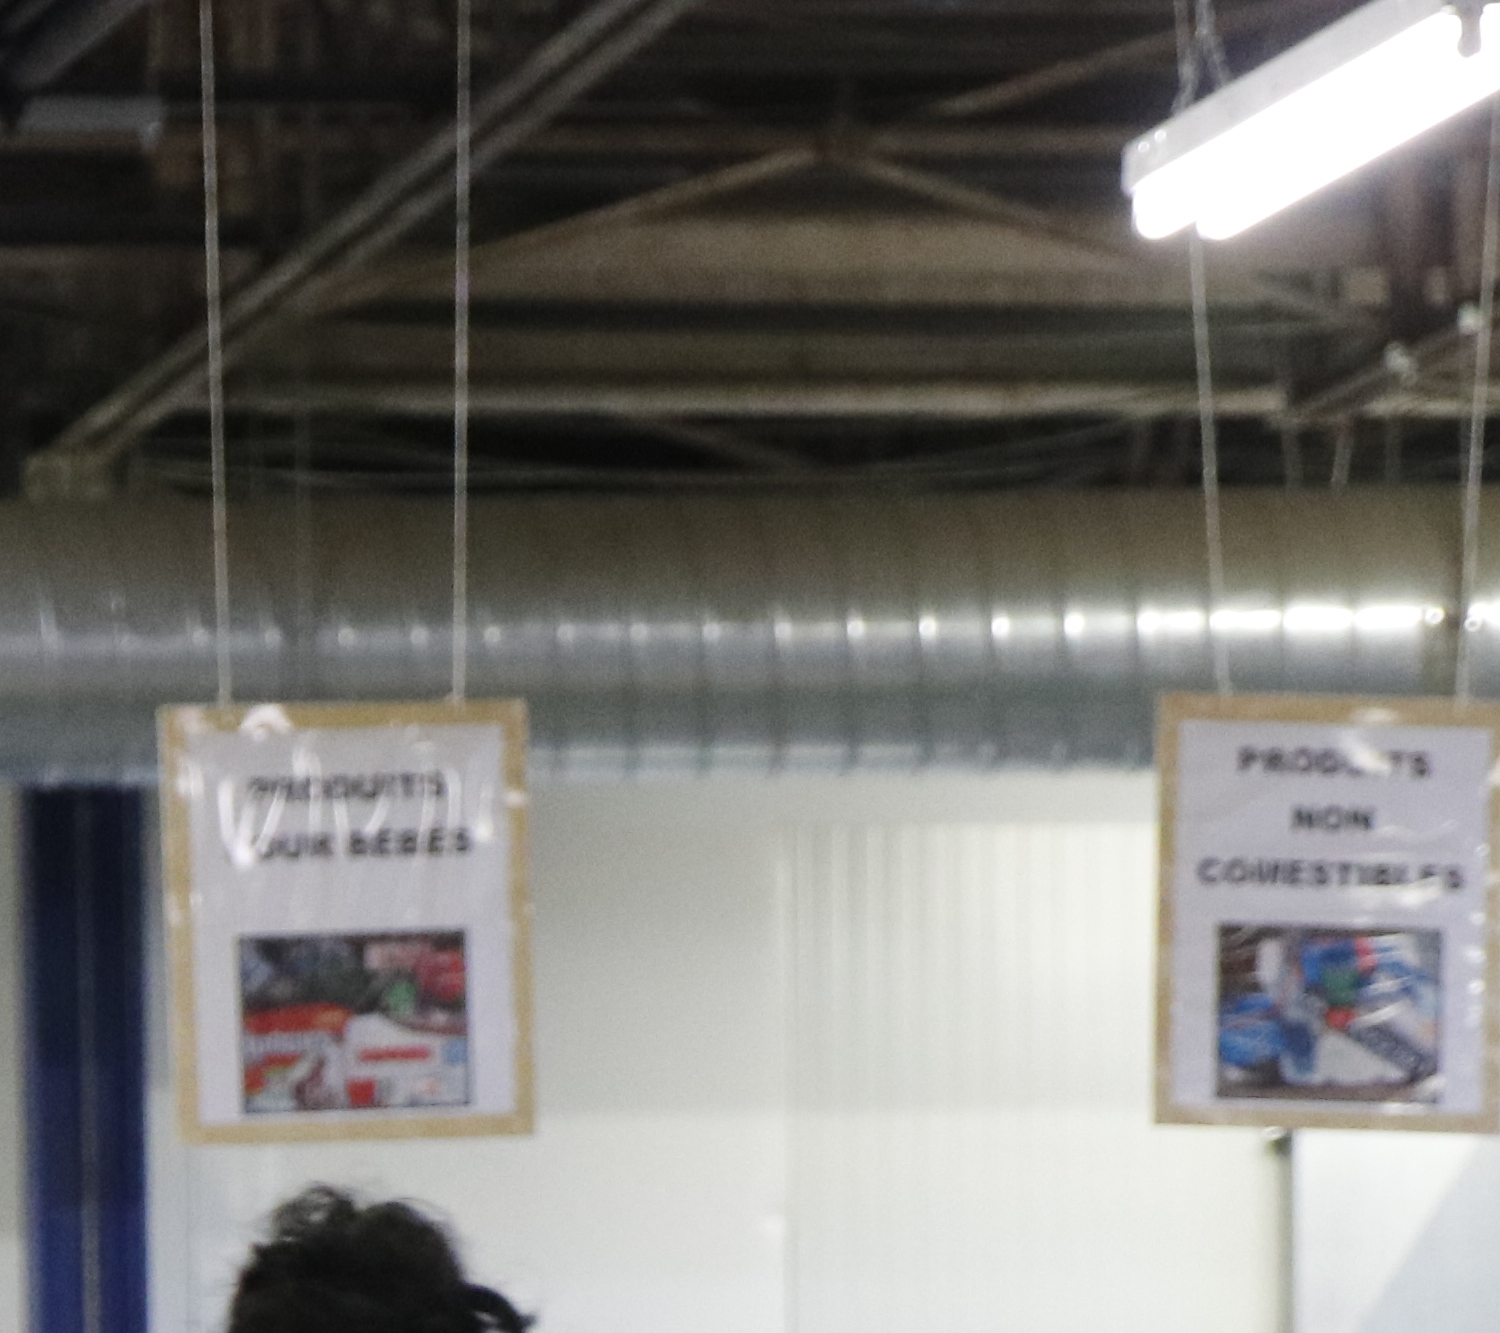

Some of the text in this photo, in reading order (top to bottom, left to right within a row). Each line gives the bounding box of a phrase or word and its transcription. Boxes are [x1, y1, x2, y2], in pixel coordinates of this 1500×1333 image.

[1238, 746, 1431, 778] PRODTS
[1291, 805, 1376, 831] NON
[256, 830, 334, 861] OUR
